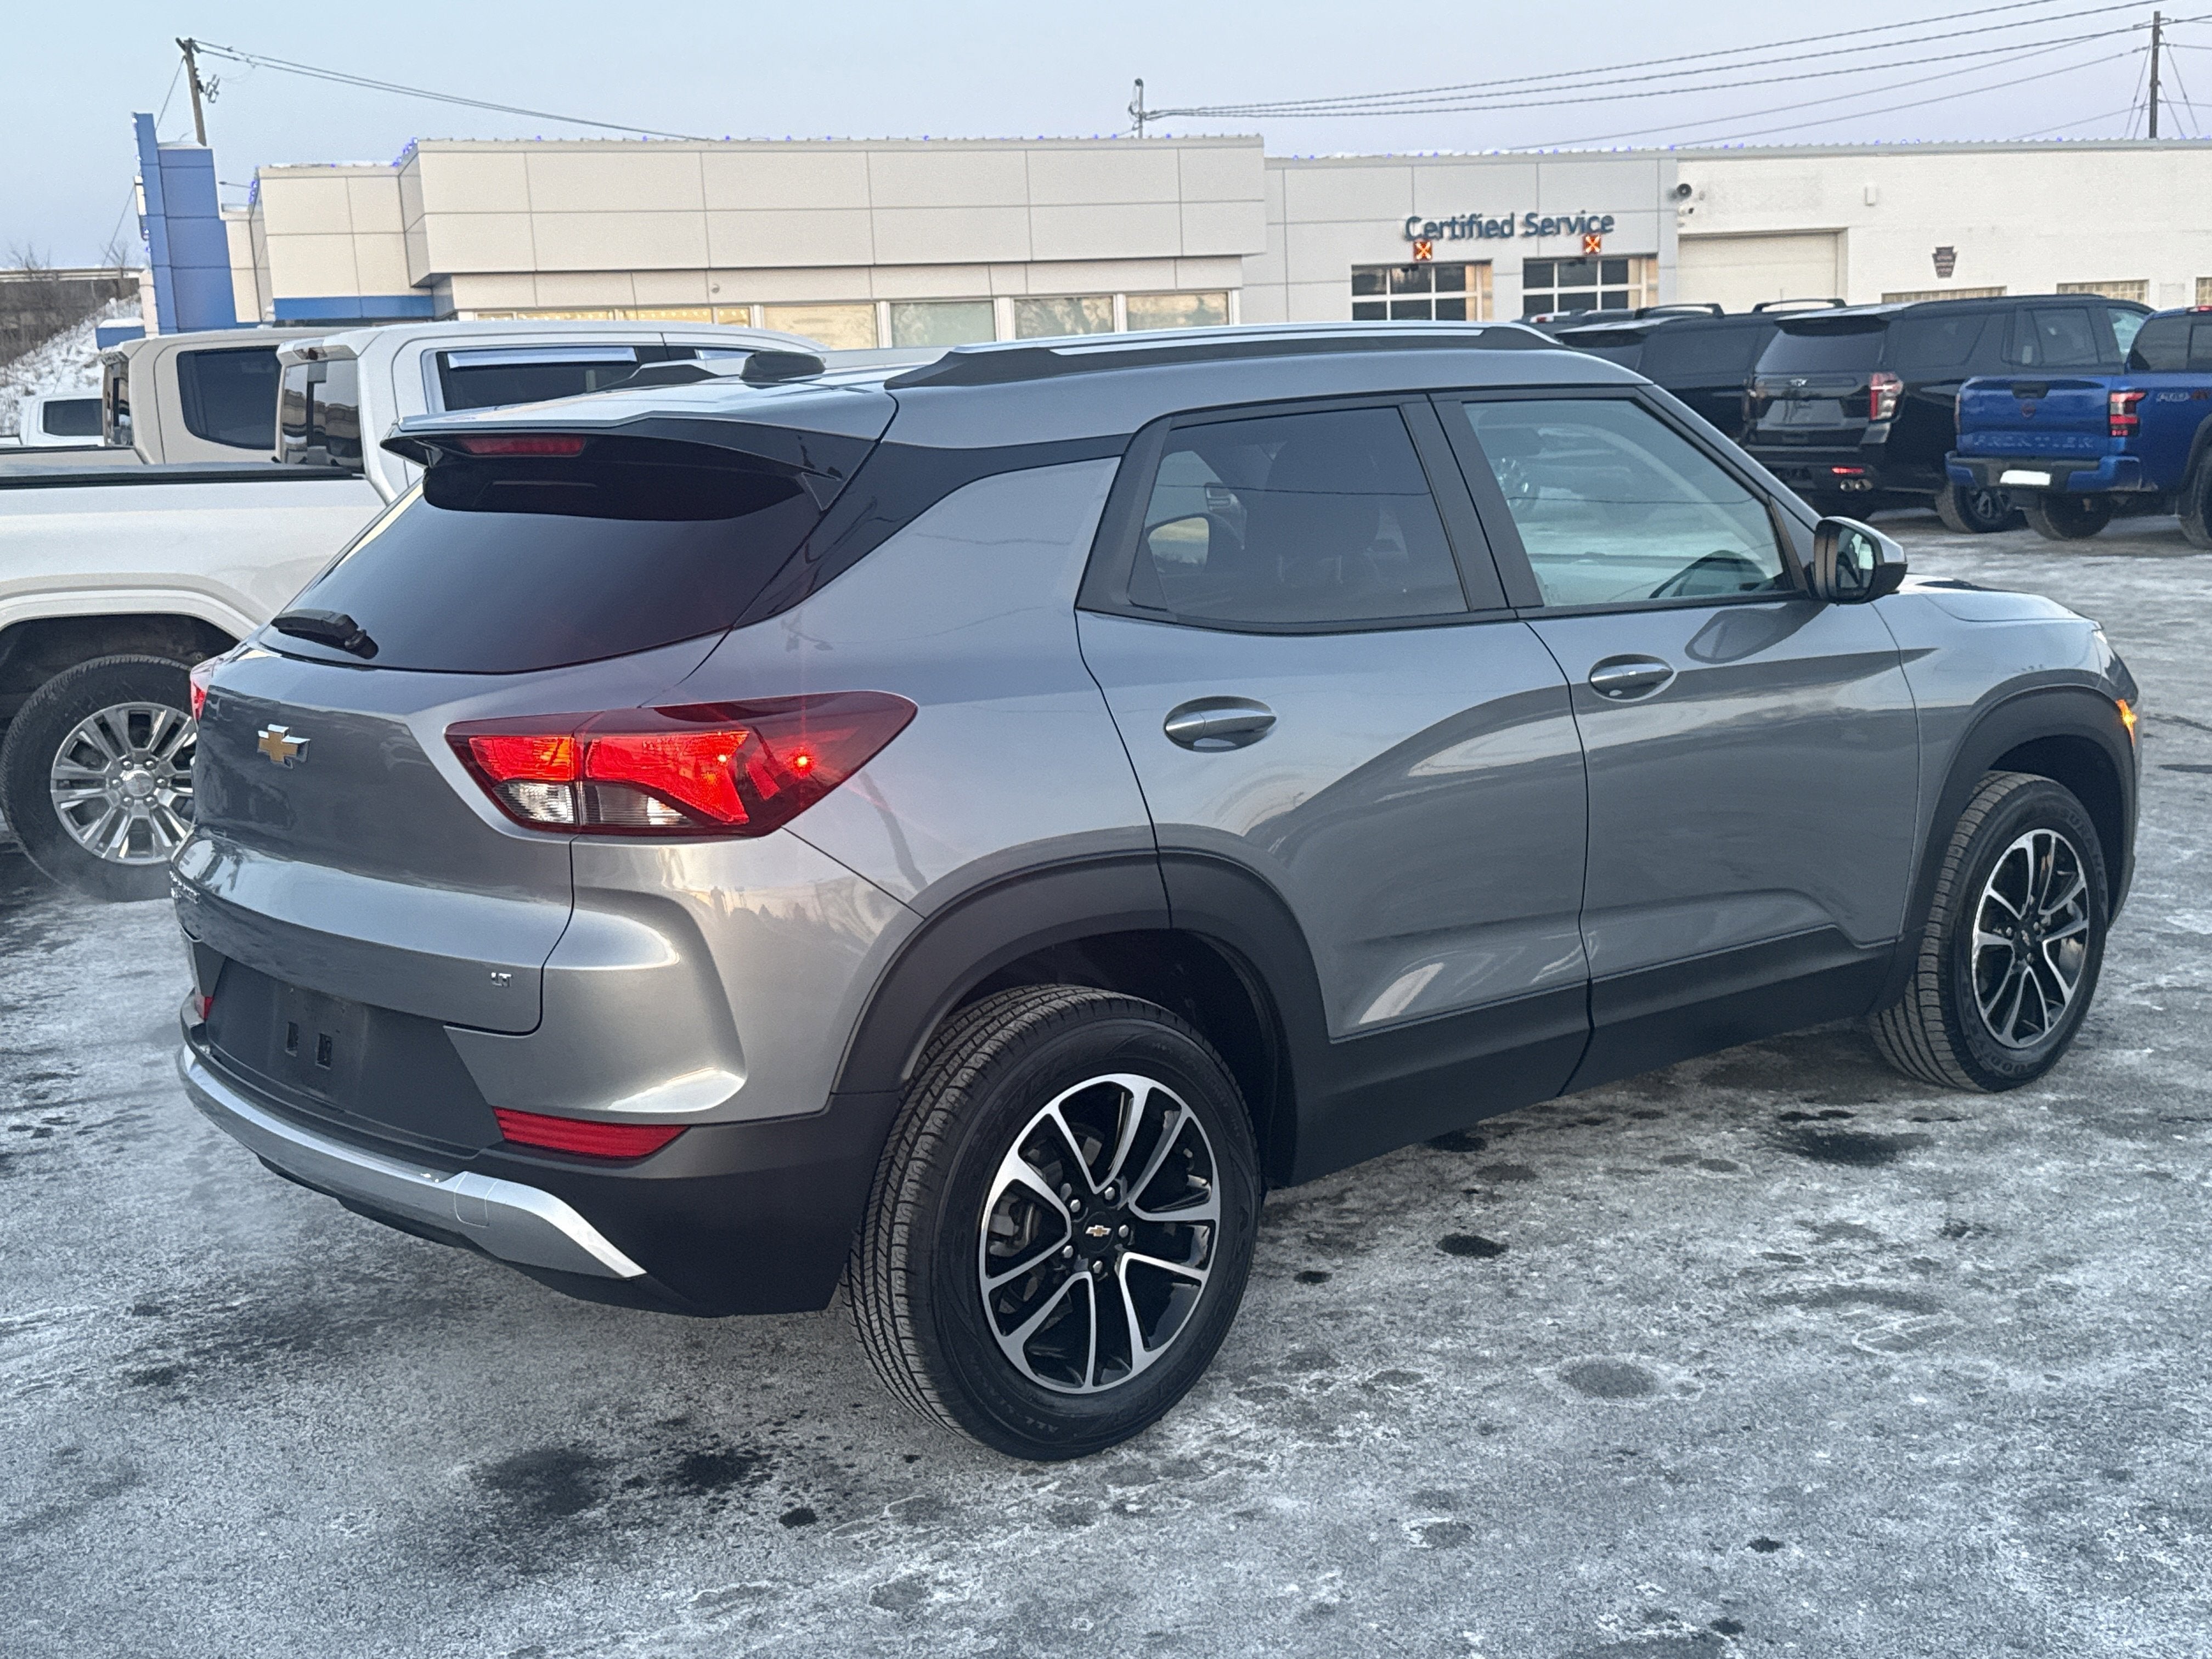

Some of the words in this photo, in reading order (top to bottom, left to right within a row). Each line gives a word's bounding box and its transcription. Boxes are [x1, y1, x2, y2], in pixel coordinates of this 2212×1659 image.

[1405, 213, 1515, 240] Certified
[1523, 210, 1615, 237] Service
[491, 972, 512, 987] LT
